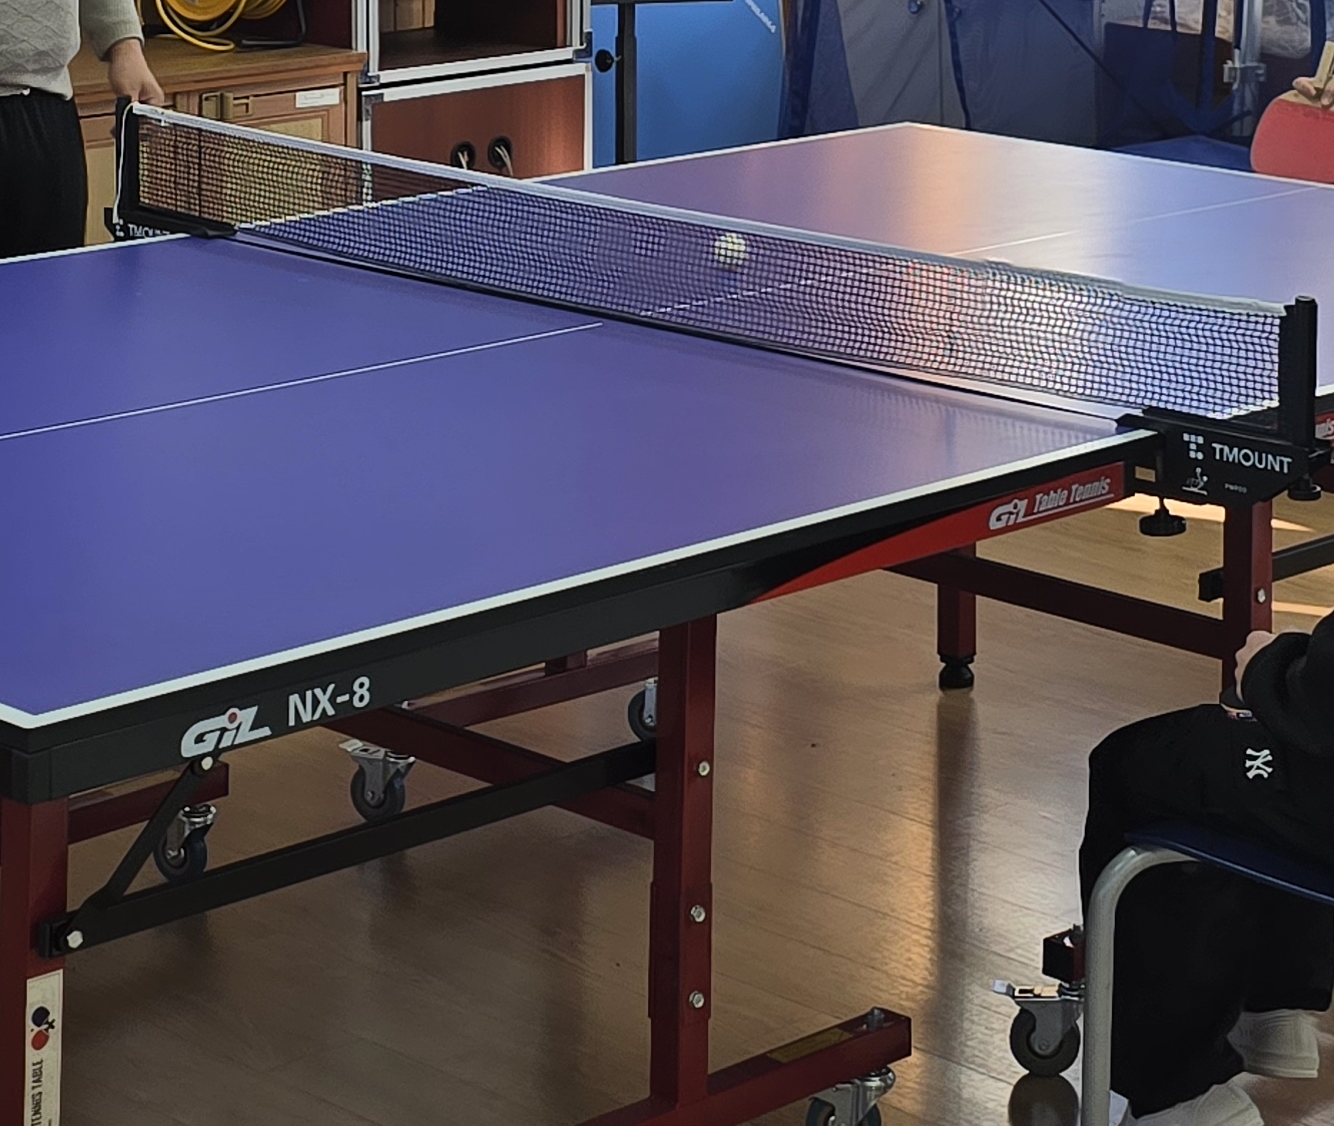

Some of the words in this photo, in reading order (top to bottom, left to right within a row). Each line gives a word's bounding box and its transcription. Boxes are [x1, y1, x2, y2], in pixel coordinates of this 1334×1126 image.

[1212, 443, 1292, 474] TMOUNT
[1033, 488, 1068, 513] Table
[1070, 476, 1111, 502] Tennis
[288, 676, 370, 726] NX-8
[31, 1059, 44, 1091] TABLE
